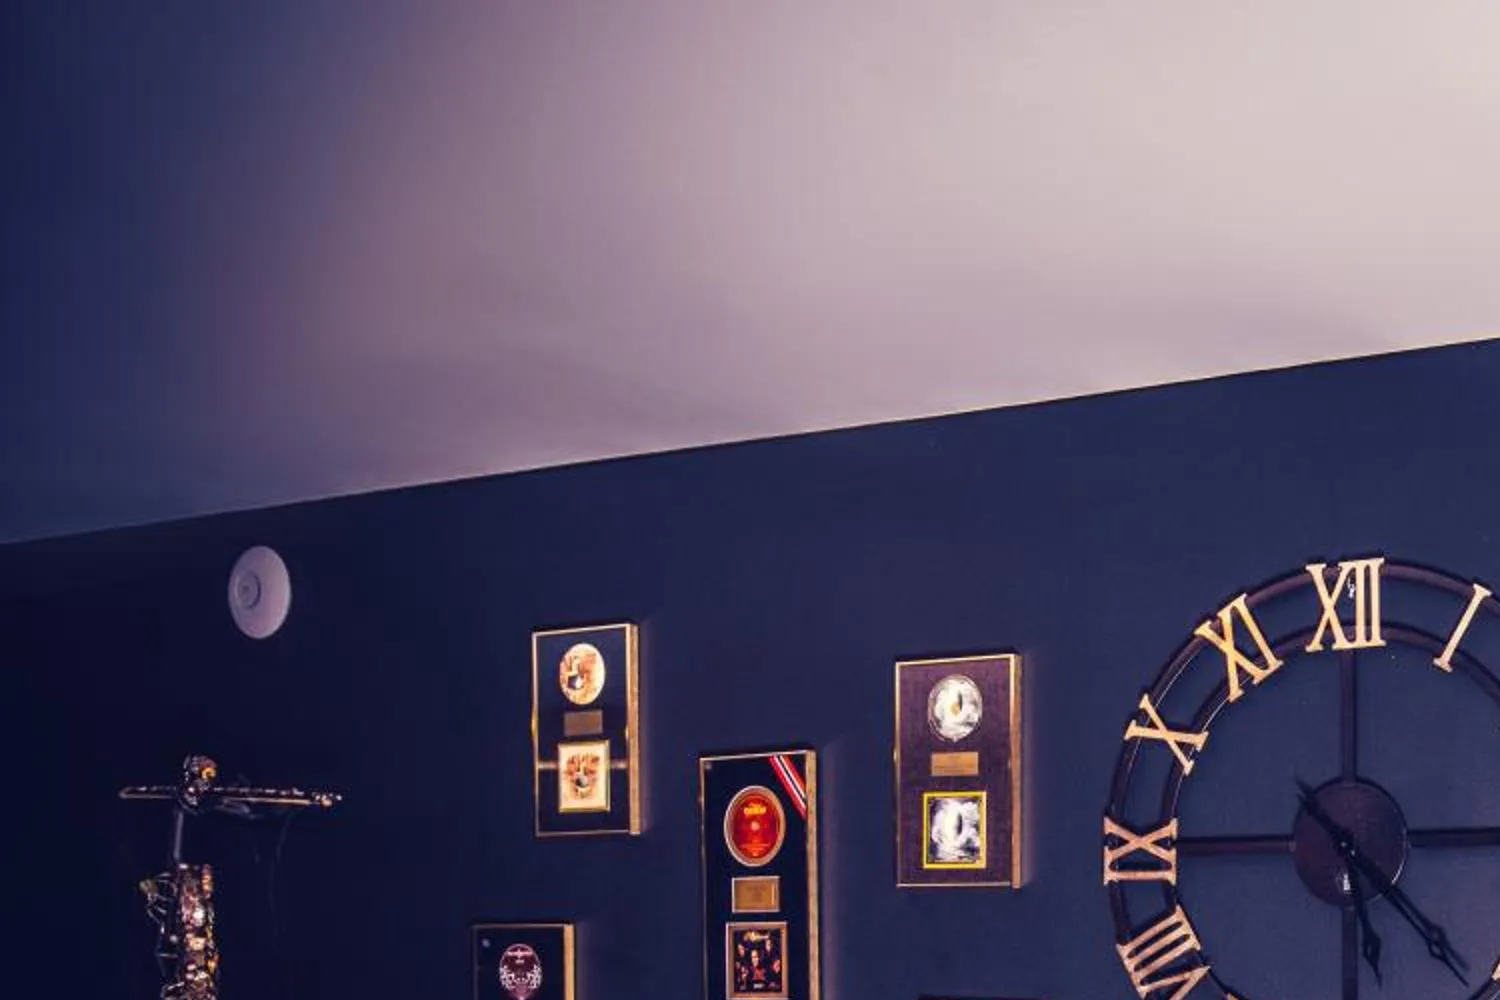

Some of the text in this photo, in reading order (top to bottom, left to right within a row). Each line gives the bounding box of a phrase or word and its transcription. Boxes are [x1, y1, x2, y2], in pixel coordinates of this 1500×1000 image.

[1195, 593, 1284, 702] XI
[1305, 557, 1386, 652] XII
[1433, 583, 1492, 673] I
[1124, 694, 1209, 775] X
[1104, 816, 1178, 886] IX
